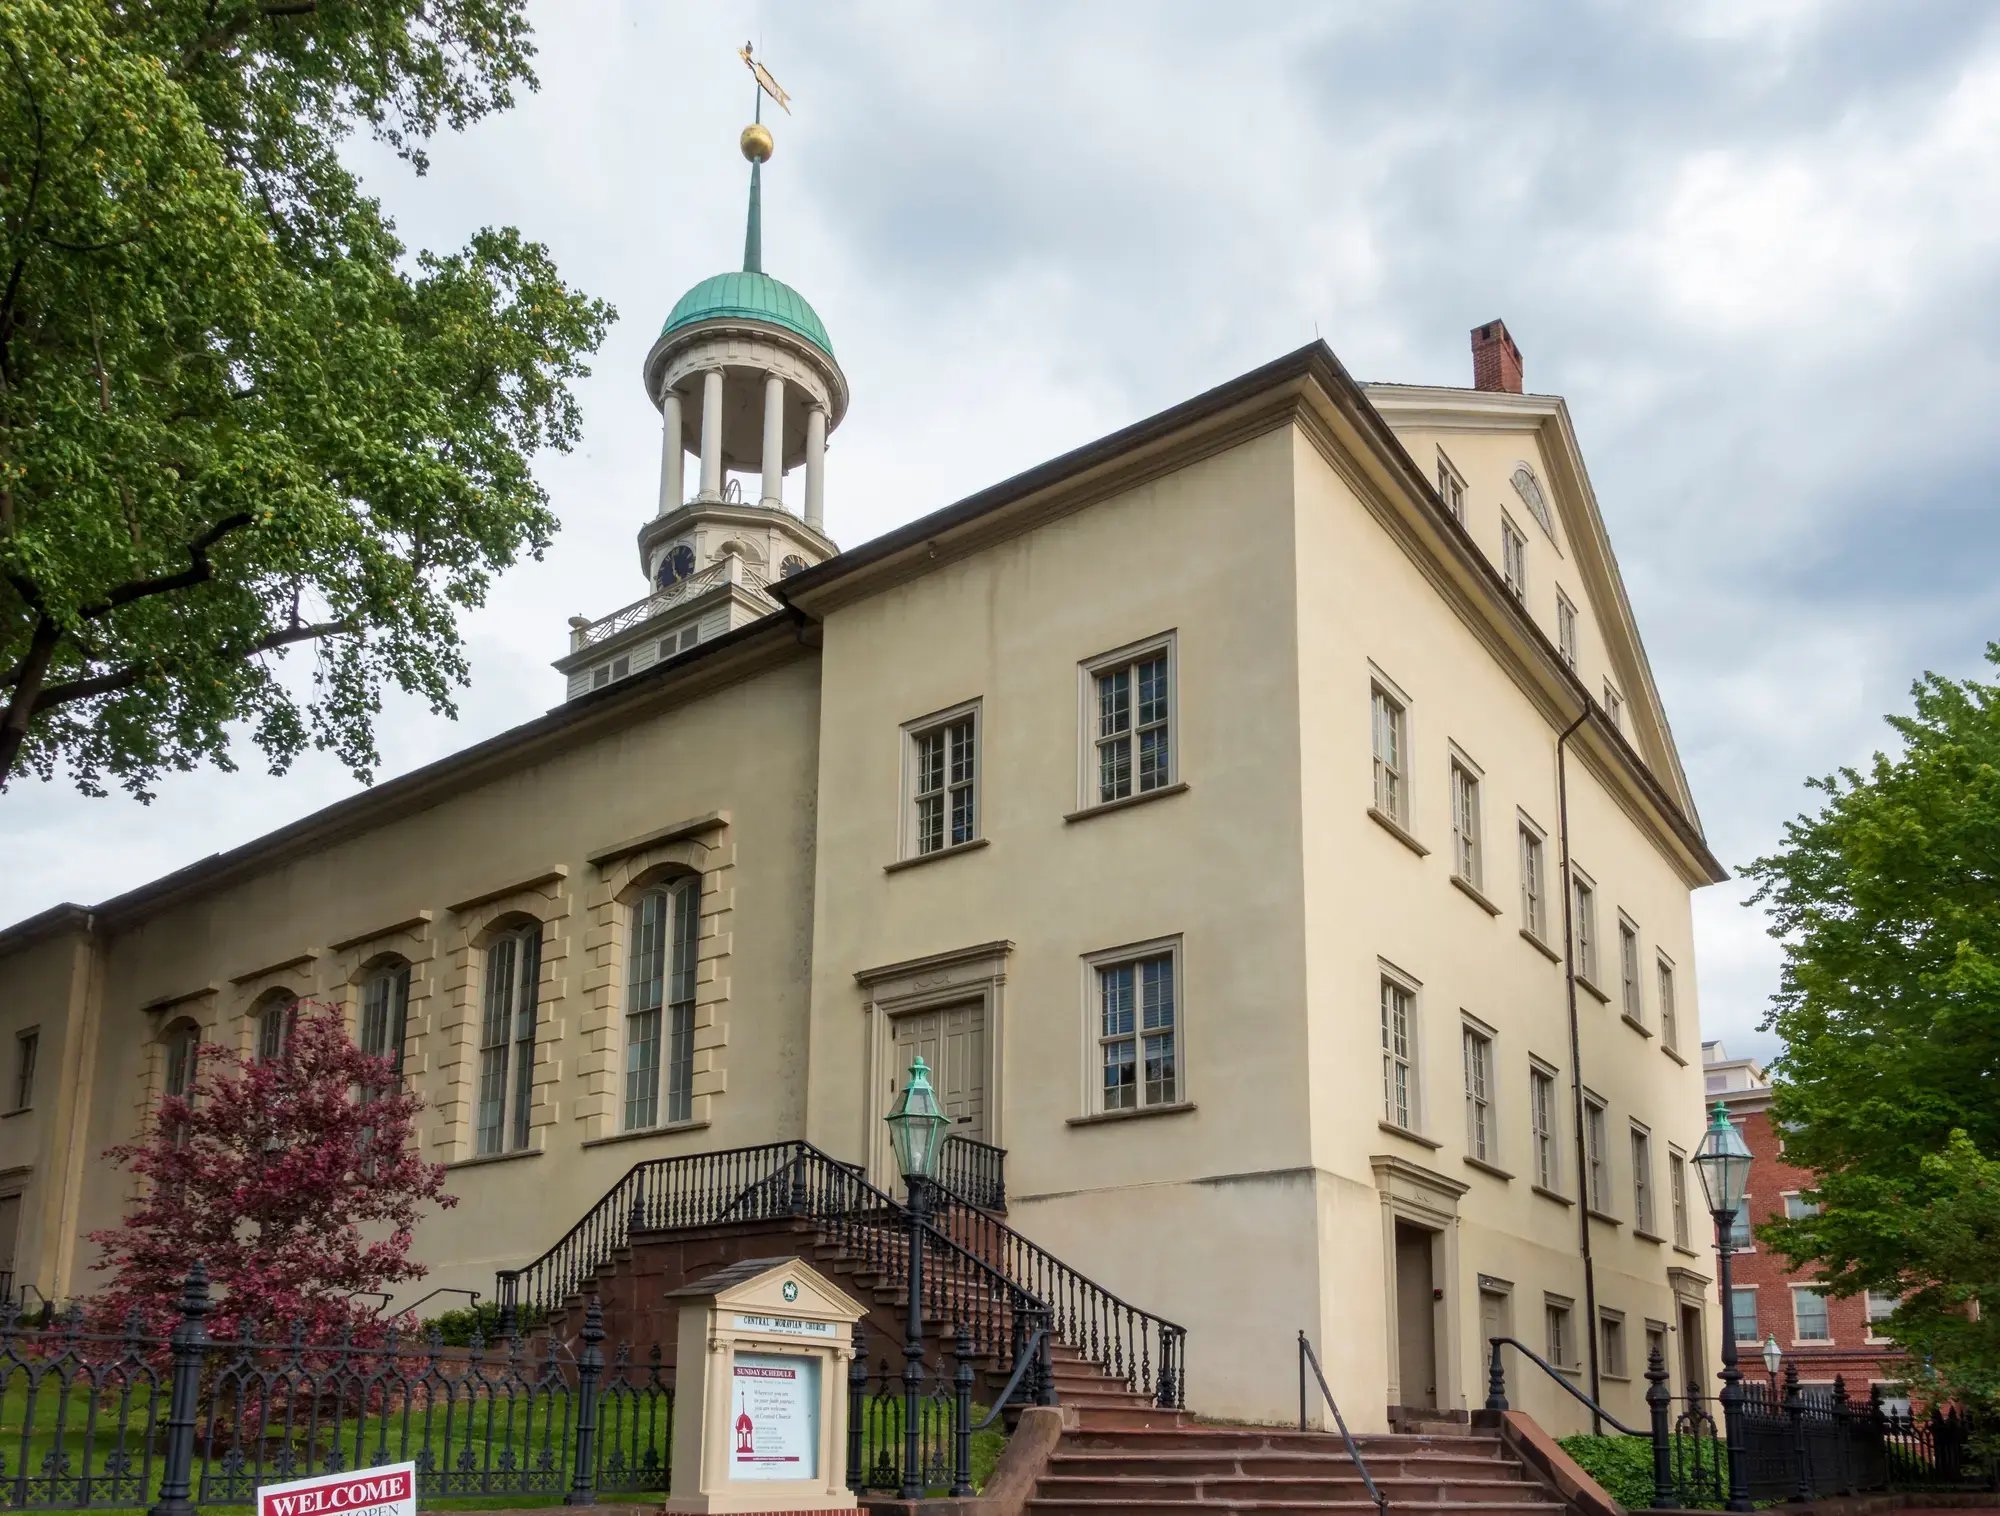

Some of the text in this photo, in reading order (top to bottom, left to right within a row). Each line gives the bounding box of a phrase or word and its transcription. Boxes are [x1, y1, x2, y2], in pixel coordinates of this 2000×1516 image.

[743, 1315, 770, 1327] CENTRAL
[774, 1318, 803, 1329] MORAVIAN
[805, 1321, 827, 1332] CHURCH
[736, 1368, 793, 1379] SUNDAY SCHEDULE
[272, 1477, 404, 1516] WELCOME
[355, 1503, 399, 1516] OPEN
